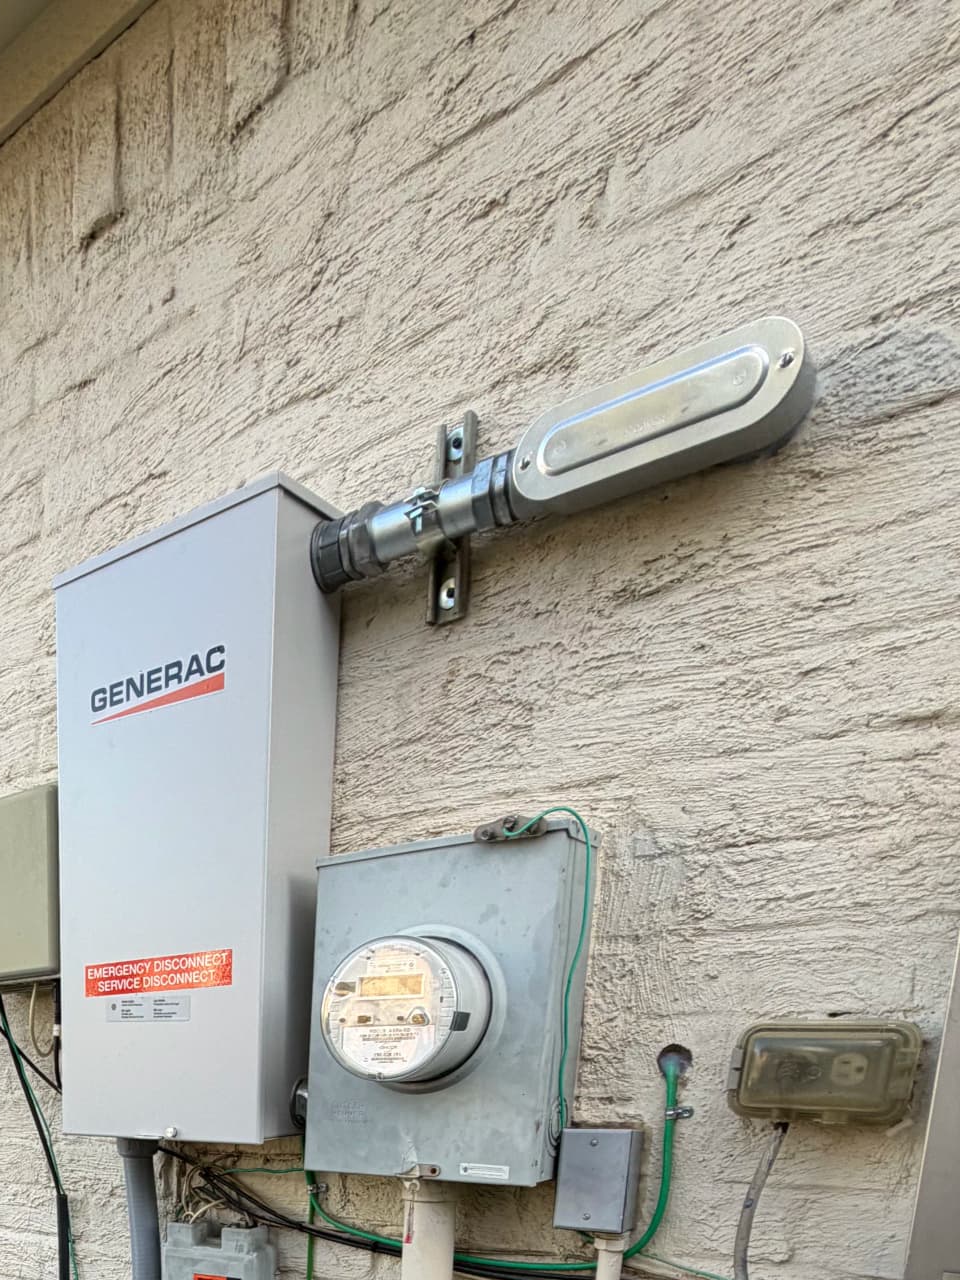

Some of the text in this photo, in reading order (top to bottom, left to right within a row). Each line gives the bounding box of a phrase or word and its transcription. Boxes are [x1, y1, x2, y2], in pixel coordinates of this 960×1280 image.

[91, 645, 225, 712] GENERAC
[87, 952, 228, 979] EMERGENCY DISCONNECT
[97, 969, 215, 992] SERVICE DISCONNECT
